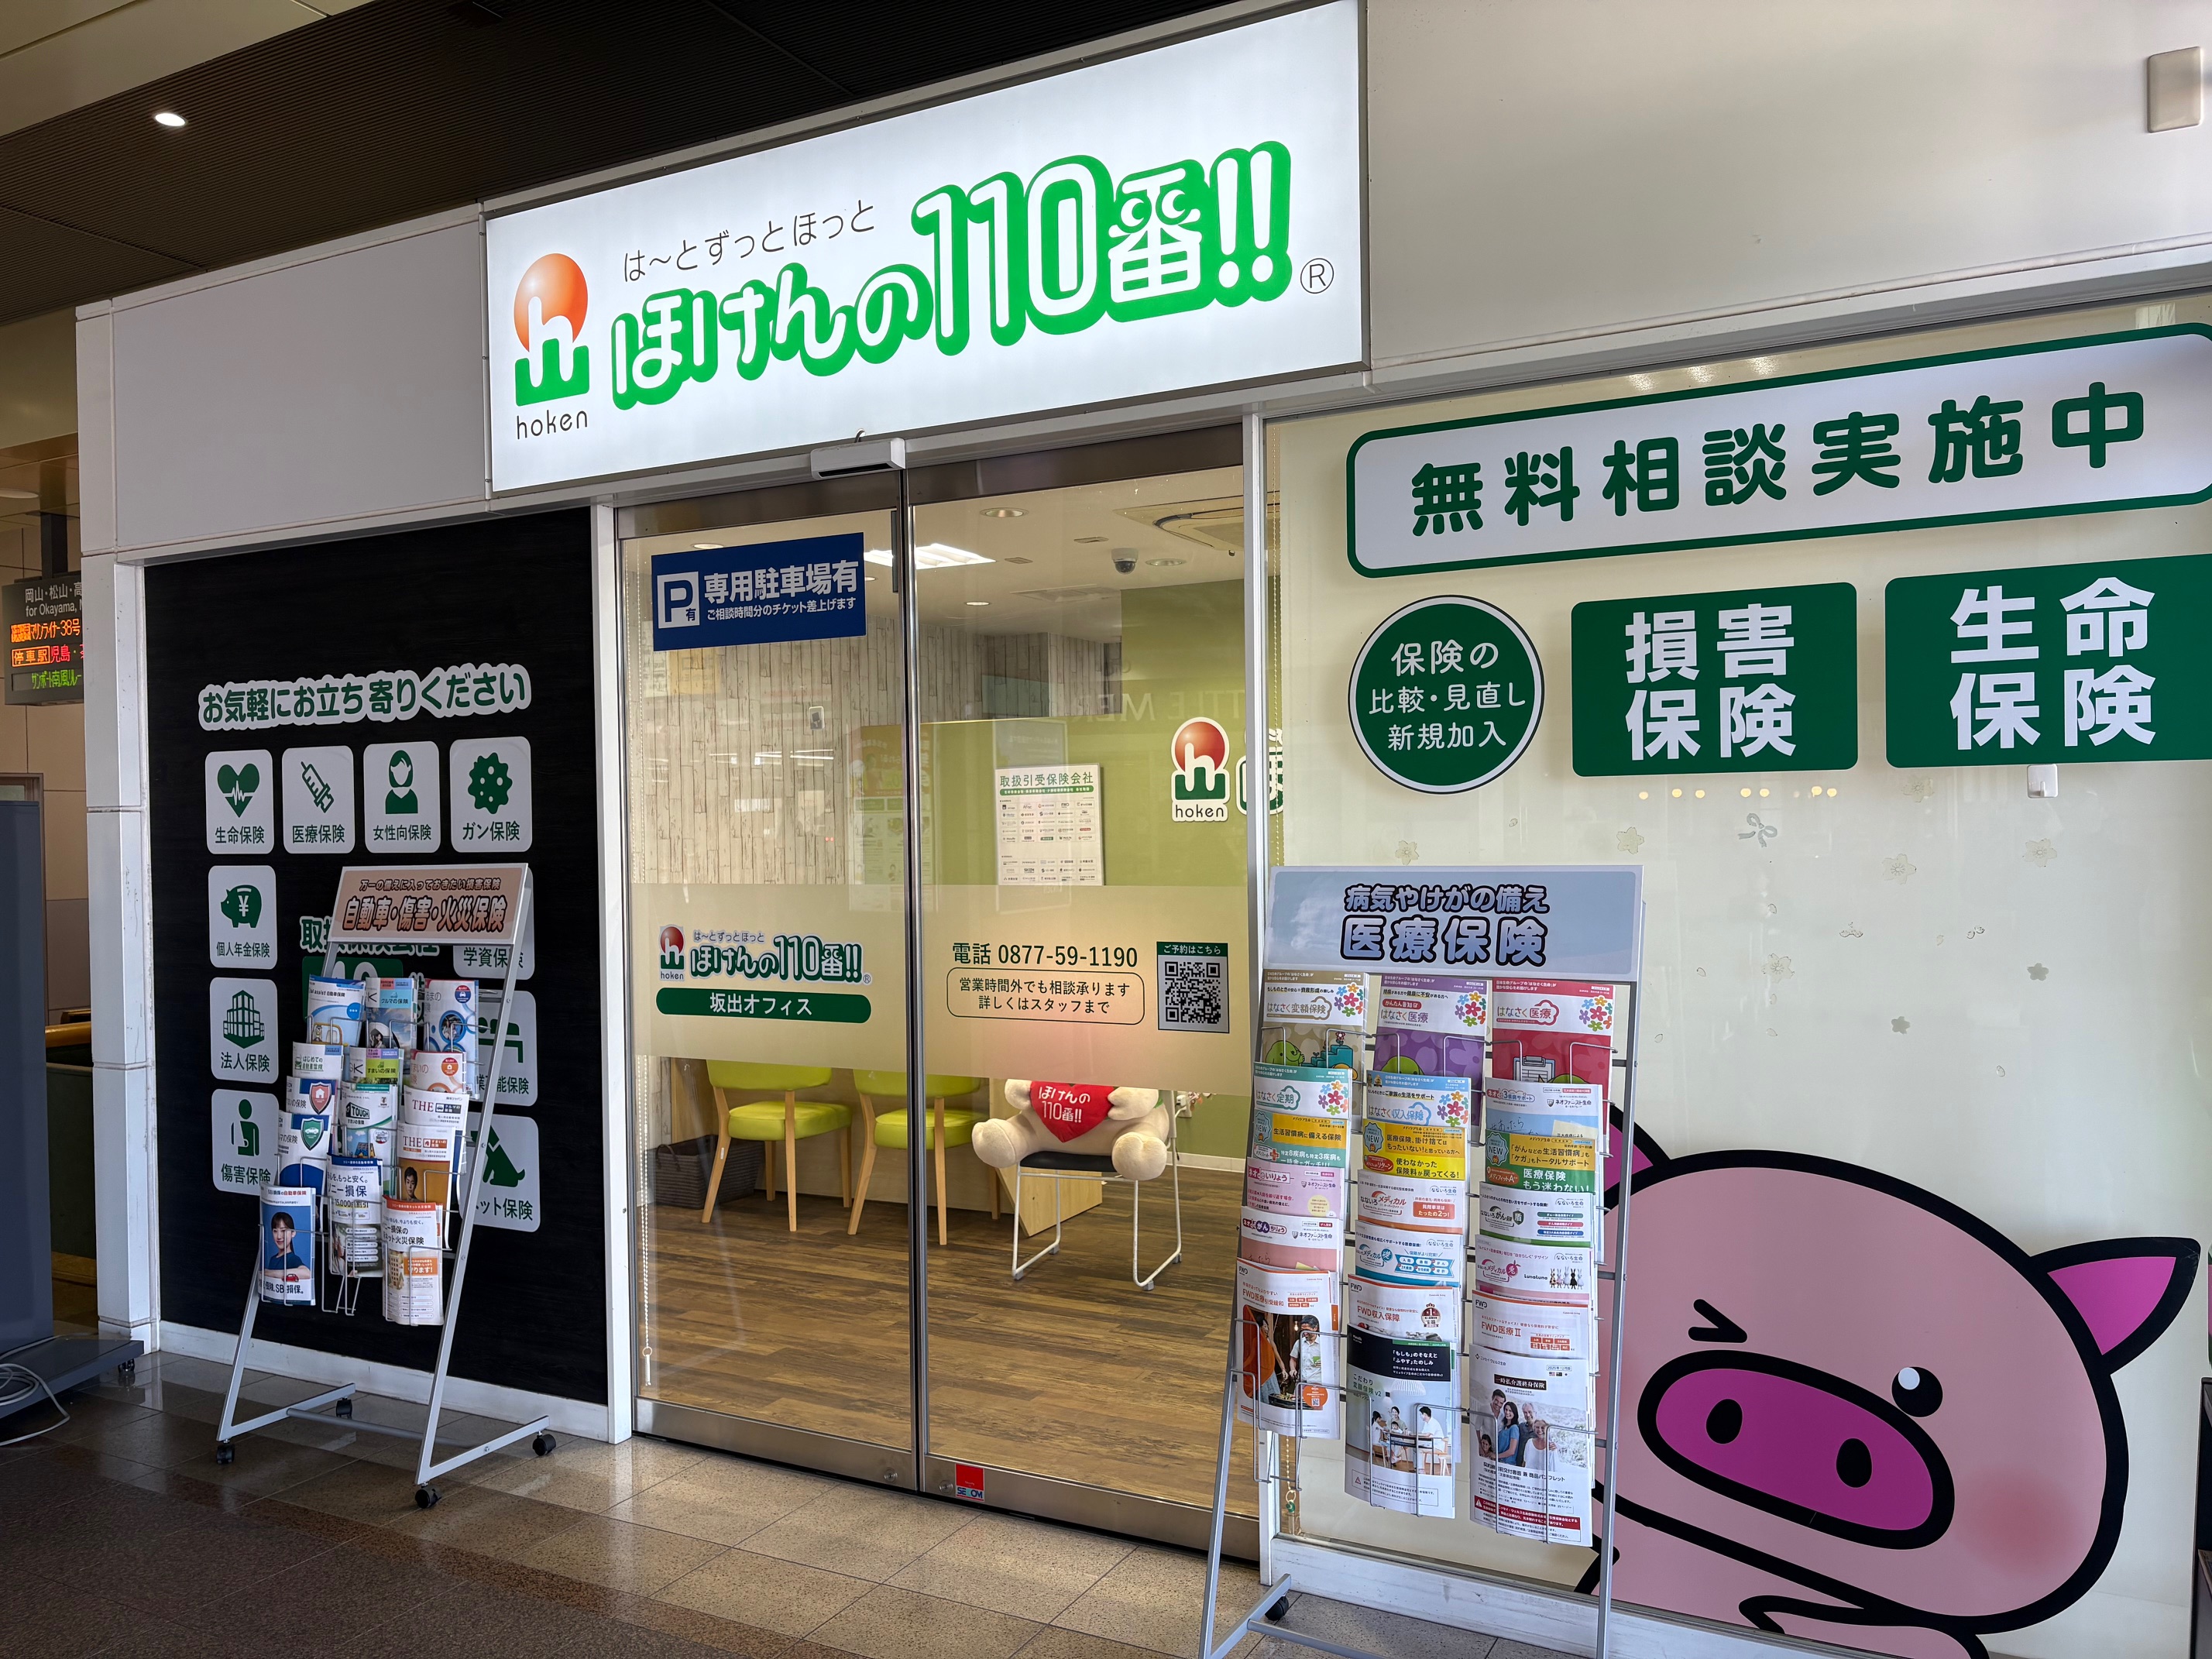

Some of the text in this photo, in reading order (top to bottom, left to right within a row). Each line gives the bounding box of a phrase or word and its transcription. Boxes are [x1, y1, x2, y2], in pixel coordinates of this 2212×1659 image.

[516, 410, 589, 440] hoken
[1410, 380, 2145, 538] 無料相談実施中
[704, 559, 859, 604] 専用駐車場有
[26, 606, 37, 617] for
[39, 603, 77, 617] Okayama,
[685, 607, 696, 622] 有
[707, 596, 857, 621] ご相談時間分のチケット差上げます
[1949, 577, 2155, 664] 生命
[1626, 603, 1795, 685] 損害
[1390, 640, 1499, 677] 保険の
[203, 671, 526, 723] お気軽にお立ち寄りください
[1369, 682, 1527, 715] 比較・見直し
[1949, 665, 2157, 750] 保険
[1626, 685, 1797, 761] 保険
[1386, 720, 1508, 751] 新規加入
[1000, 772, 1094, 787] 取扱引受保険会社
[1175, 805, 1224, 818] hoken
[215, 826, 265, 845] 生命保険
[292, 824, 345, 844] 医療保険
[373, 824, 432, 842] 女性向保険
[462, 820, 520, 842] ガン保険
[359, 878, 501, 891] 万一の備えに入っておきたい損害保険
[1345, 884, 1549, 914] 病気やけがの備え
[342, 895, 508, 933] 自動車・傷害・火災保険
[1163, 944, 1221, 954] ご予約はこちら
[1340, 915, 1547, 967] 医療保険
[216, 941, 270, 959] 個人年金保険
[953, 943, 1139, 967] 電話 0877-59-1190
[661, 971, 684, 980] hoken
[959, 977, 1130, 997] 営業時間外でも相談承ります
[709, 992, 812, 1016] 坂出オフィス
[978, 995, 1110, 1014] 詳しくはスタッフまで
[1267, 1002, 1326, 1014] はなさく変額保険
[1497, 1006, 1551, 1019] はなさく医療
[1381, 1008, 1429, 1023] はなさく医療
[220, 1050, 270, 1073] 法人保険
[1039, 1085, 1091, 1104] ほけんの
[1255, 1090, 1294, 1104] はなさく定期
[352, 1105, 369, 1118] TOUGH
[412, 1099, 434, 1112] THE
[1042, 1101, 1082, 1123] 110番!!
[1368, 1104, 1424, 1121] はなさく収入保障
[404, 1135, 422, 1147] THE
[1273, 1128, 1341, 1141] 生活習慣病に備える保険
[1365, 1134, 1379, 1143] NEW
[1386, 1134, 1448, 1146] 医療保険、掛け捨ては
[1386, 1143, 1460, 1155] もったいない!と思っている方へ
[1488, 1146, 1503, 1155] NEW
[1510, 1144, 1590, 1158] 「がんなどの生活習慣病」も
[1396, 1158, 1437, 1168] 使わなかった
[1510, 1153, 1589, 1166] 「ケガ」もトータルサポート
[221, 1164, 271, 1186] 傷害保険
[1396, 1166, 1459, 1178] 保険料が戻ってくる!
[1523, 1168, 1566, 1181] 医療保険
[476, 1197, 533, 1221] ット保険
[1238, 1266, 1249, 1274] FWD
[1350, 1283, 1362, 1291] FWD
[1475, 1299, 1488, 1308] FWD
[1357, 1305, 1400, 1322] FWD収入保障
[1393, 1349, 1438, 1358] 「もしも」のそなえと
[1353, 1373, 1373, 1386] こだわり
[957, 1487, 983, 1499] SECOM
